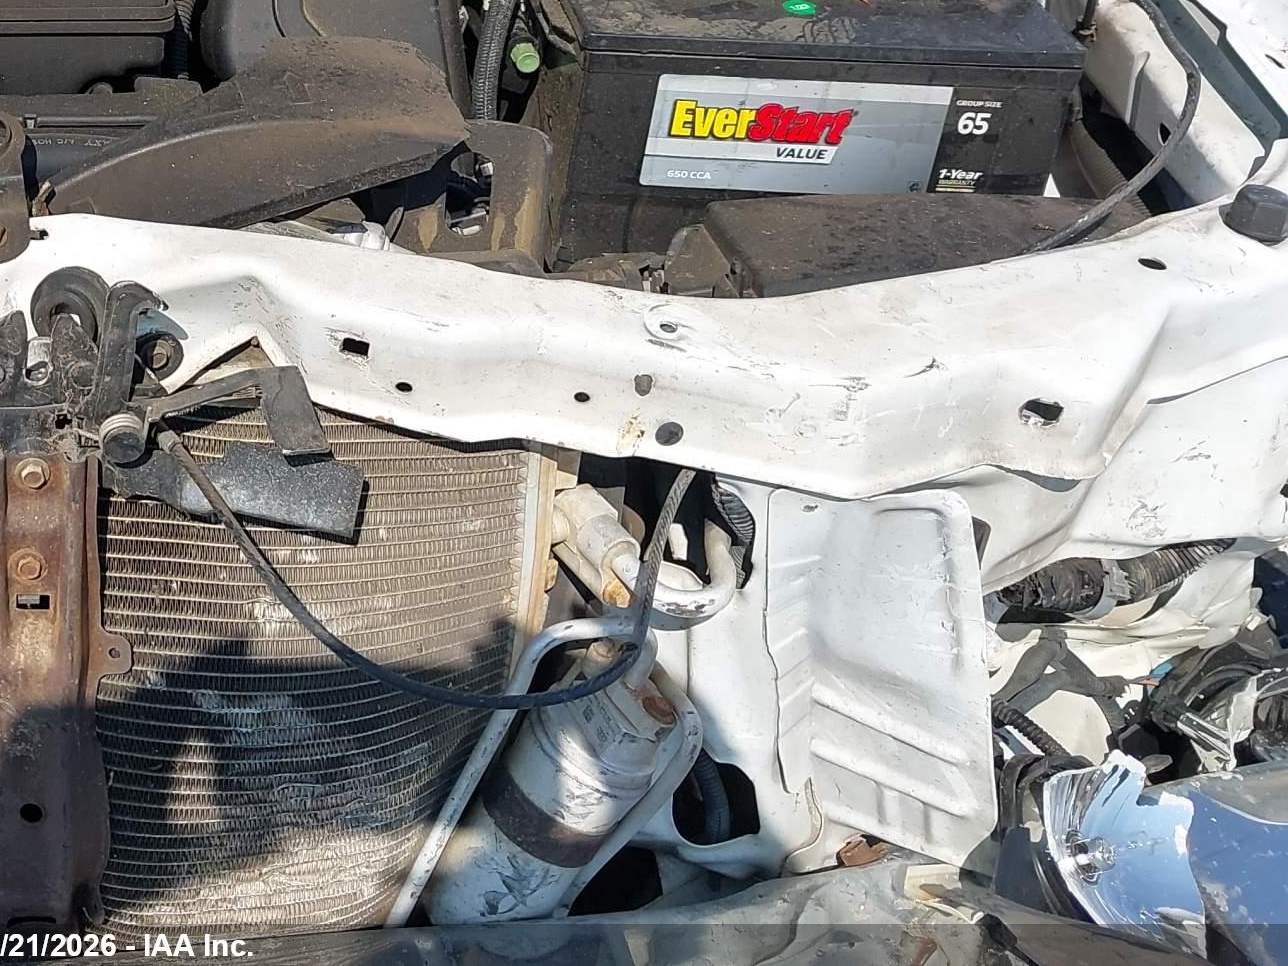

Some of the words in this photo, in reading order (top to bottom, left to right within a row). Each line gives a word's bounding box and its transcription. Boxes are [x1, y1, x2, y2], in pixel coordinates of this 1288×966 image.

[956, 99, 984, 108] GROUP
[669, 98, 854, 145] EverStart
[957, 111, 992, 135] 65
[776, 147, 828, 160] VALUE
[667, 170, 688, 179] 650
[690, 171, 712, 180] CCA
[939, 168, 983, 181] 1-Year
